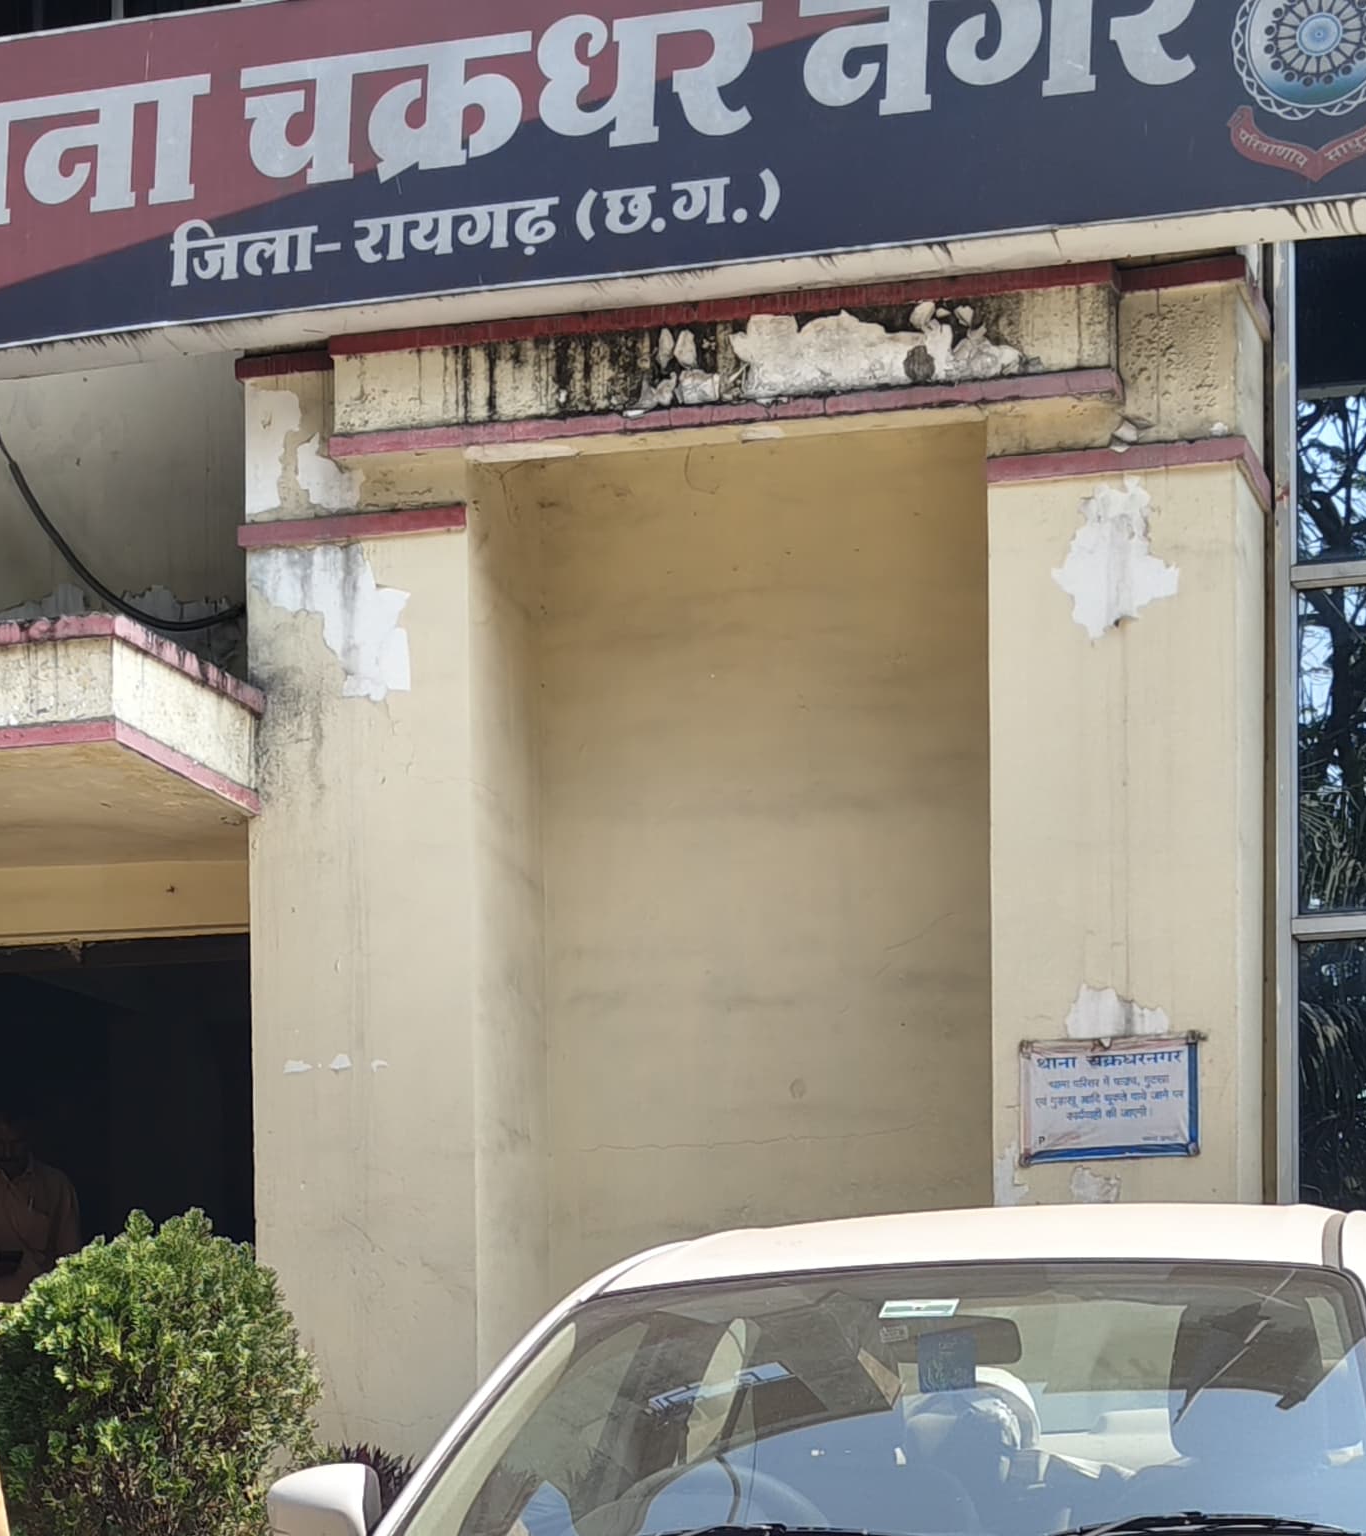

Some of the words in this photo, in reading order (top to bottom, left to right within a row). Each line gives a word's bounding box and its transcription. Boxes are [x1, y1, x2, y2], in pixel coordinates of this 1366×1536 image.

[240, 2, 763, 185] चक्रधर
[802, 0, 1196, 116] नगर
[354, 193, 560, 264] रायगढ़
[575, 168, 782, 241] (छ.ग.)
